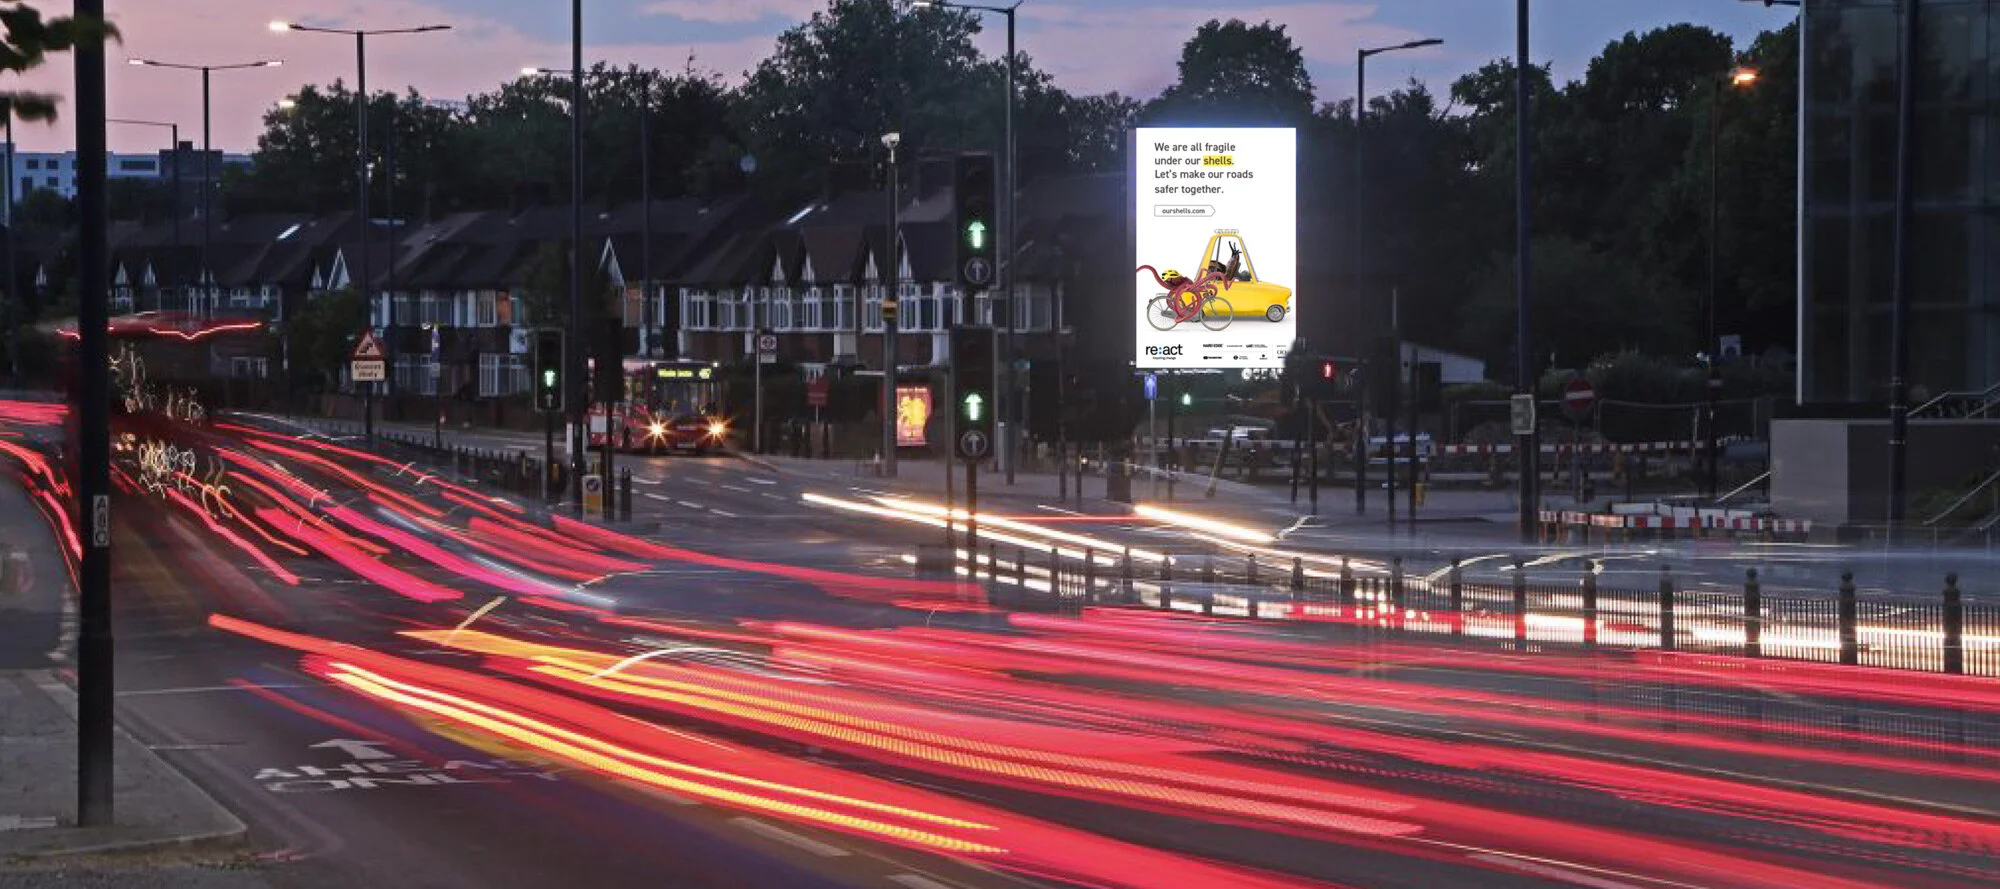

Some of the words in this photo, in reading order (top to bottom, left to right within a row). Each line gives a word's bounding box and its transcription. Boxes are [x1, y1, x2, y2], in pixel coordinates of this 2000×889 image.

[1154, 142, 1169, 152] We
[1172, 144, 1188, 152] are
[1190, 142, 1202, 152] all
[1205, 142, 1236, 153] fragile
[1154, 156, 1182, 165] under
[1203, 156, 1235, 165] shells.
[1180, 169, 1206, 179] make
[1208, 171, 1224, 179] our
[1227, 169, 1254, 179] roads
[1154, 184, 1179, 194] safer
[1181, 184, 1224, 196] together.
[1161, 207, 1206, 215] ourshells.com
[1145, 343, 1184, 356] re:act
